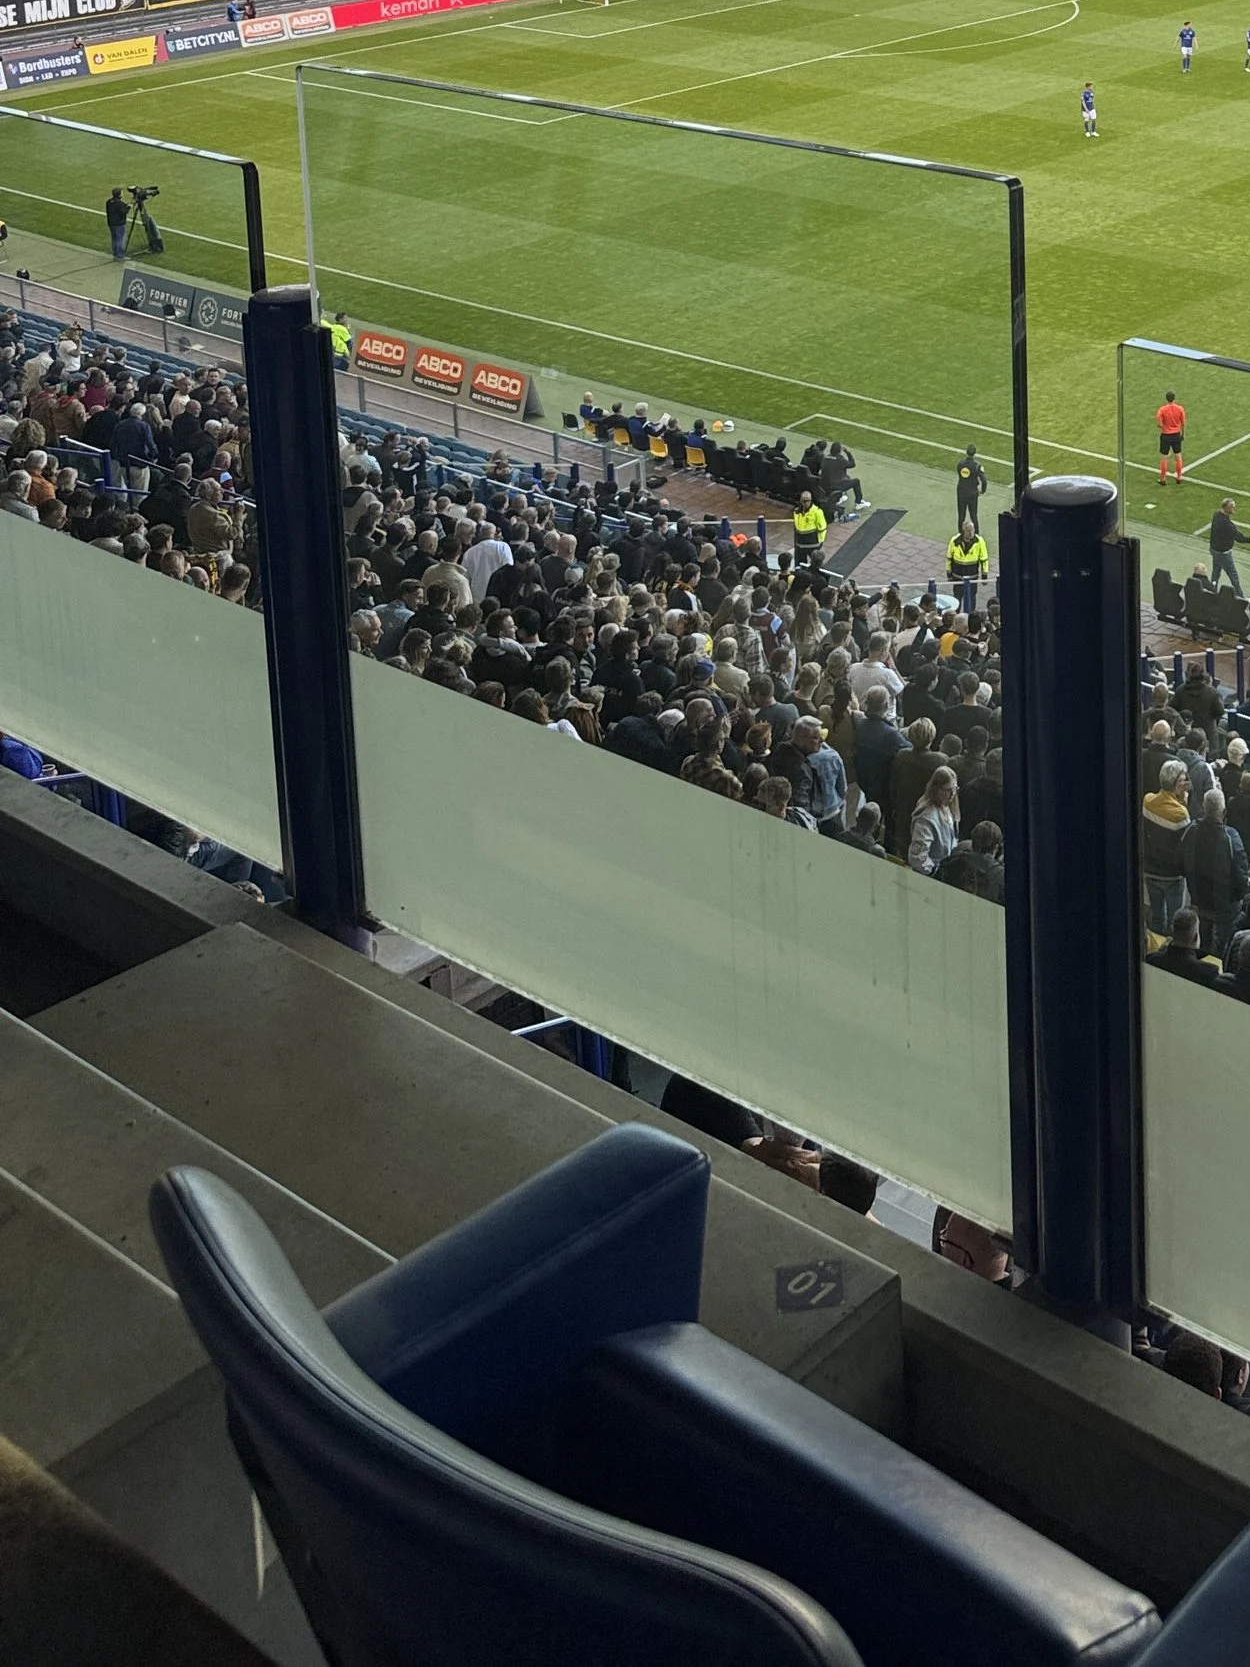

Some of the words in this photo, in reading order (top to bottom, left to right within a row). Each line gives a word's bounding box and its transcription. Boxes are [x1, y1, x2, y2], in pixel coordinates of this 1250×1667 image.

[245, 20, 280, 35] ABCO
[292, 12, 328, 27] ABCO
[176, 30, 239, 51] BETCITY.NL
[18, 54, 82, 73] Bordbusters
[150, 289, 188, 307] FORTVIER
[360, 337, 405, 361] ABCO
[357, 359, 401, 376] BEVEILIGING
[417, 353, 462, 378] ABCO
[414, 376, 458, 394] BEVEILIGING
[474, 370, 521, 395] ABCO
[472, 392, 517, 411] BEVEILIGING
